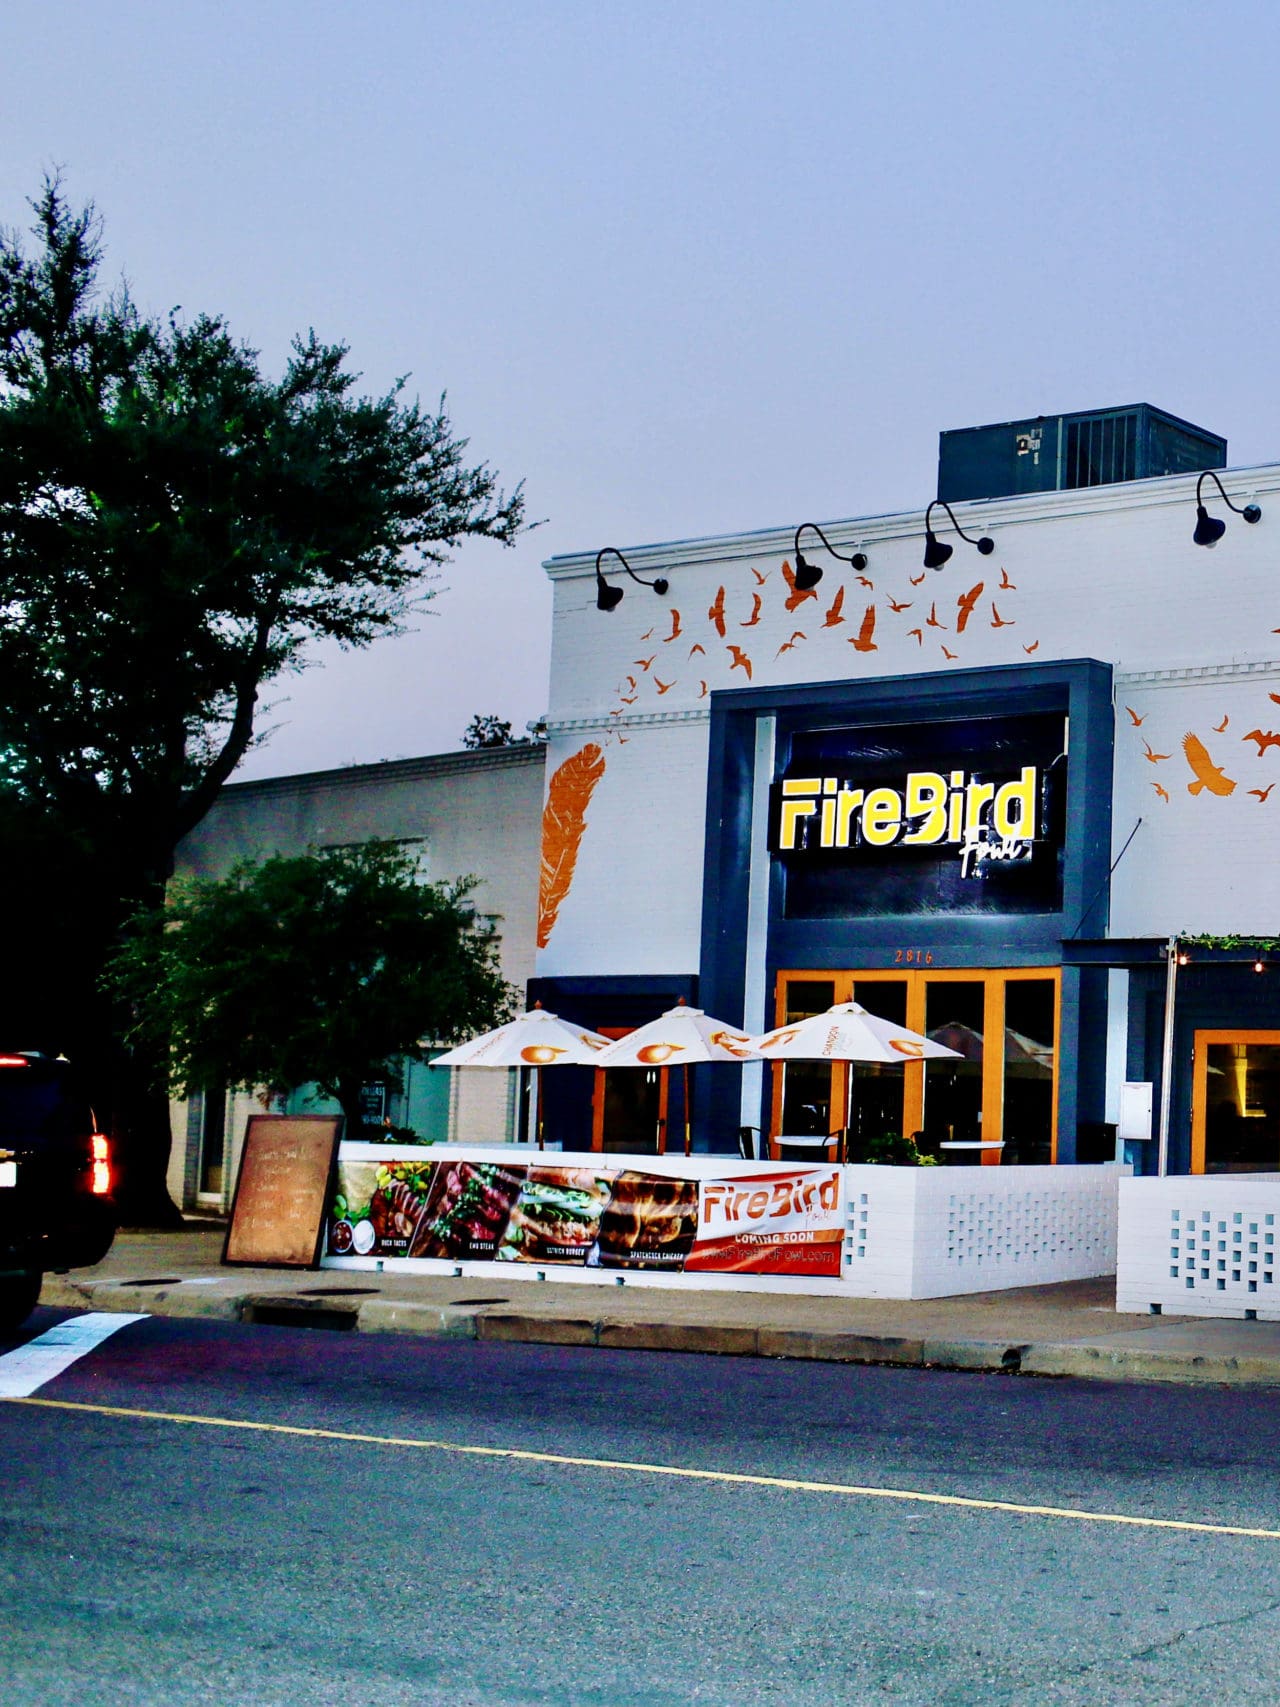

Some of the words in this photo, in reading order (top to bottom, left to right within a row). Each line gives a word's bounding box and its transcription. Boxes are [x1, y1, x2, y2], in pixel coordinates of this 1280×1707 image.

[779, 766, 1037, 850] FireBird
[894, 949, 934, 965] 2816
[703, 1171, 840, 1224] FireBird
[735, 1231, 780, 1244] COMING
[783, 1231, 814, 1243] SOON
[566, 1247, 585, 1256] BURGER
